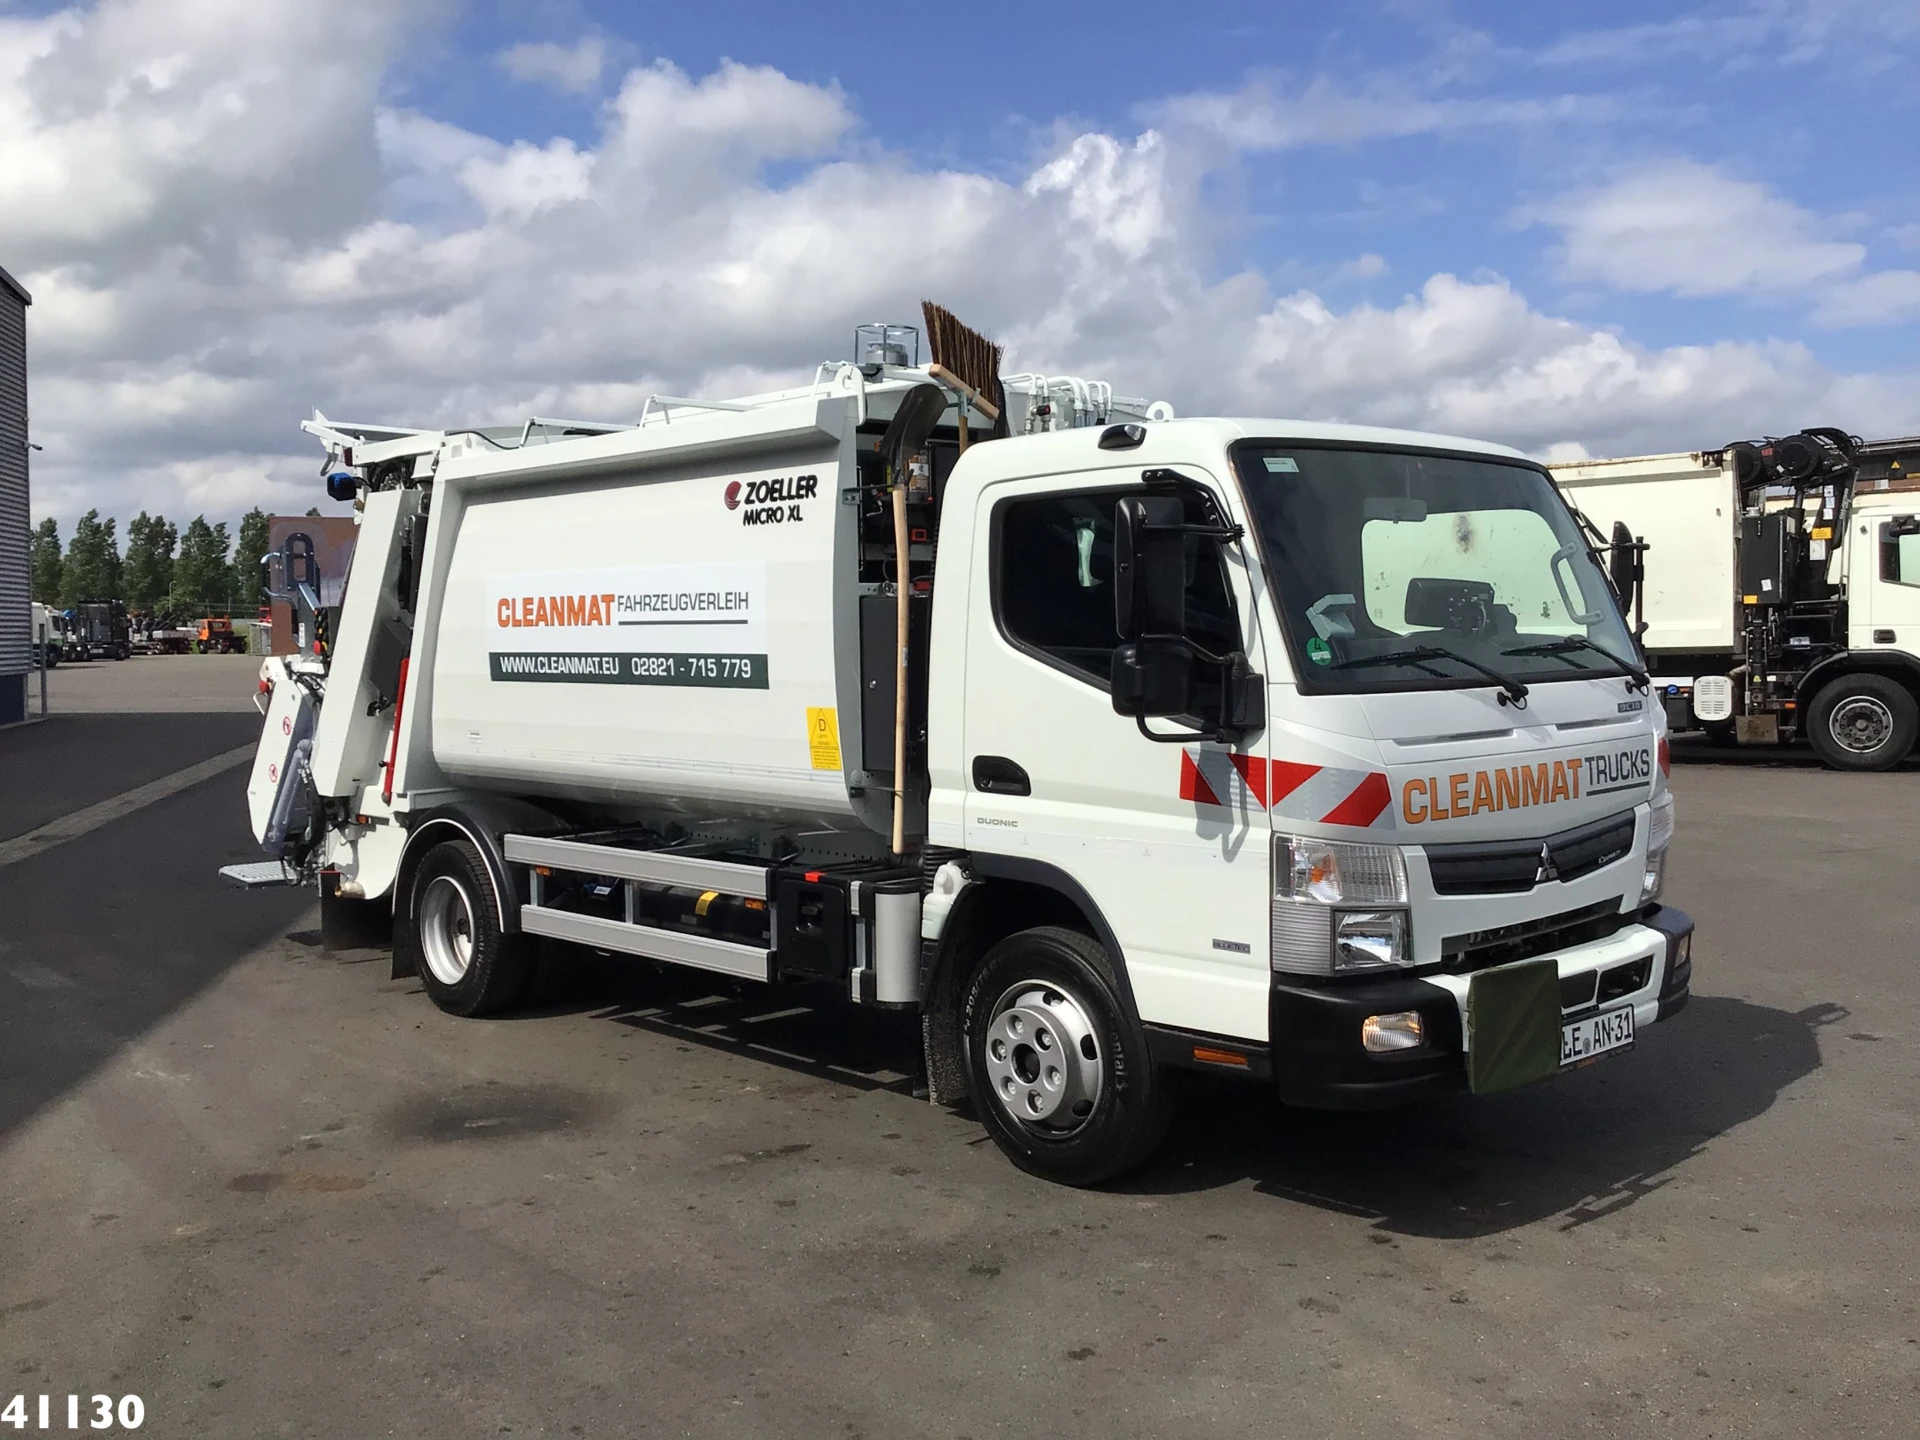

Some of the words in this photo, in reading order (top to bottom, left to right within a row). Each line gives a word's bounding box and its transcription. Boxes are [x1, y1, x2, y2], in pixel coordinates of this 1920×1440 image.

[744, 475, 817, 505] ZOELLER
[743, 506, 784, 526] MICRO
[787, 504, 803, 522] XL
[497, 594, 615, 627] CLEANMAT
[618, 592, 749, 612] FAHRZEUGVERLEIH
[500, 656, 619, 675] WWW.CLEANMAT.EU
[631, 657, 675, 676] 02821
[688, 658, 717, 677] 715
[721, 659, 751, 678] 779
[1402, 758, 1583, 825] CLEANMAT
[1584, 749, 1650, 785] TRUCKS
[977, 817, 1018, 827] DUONIC
